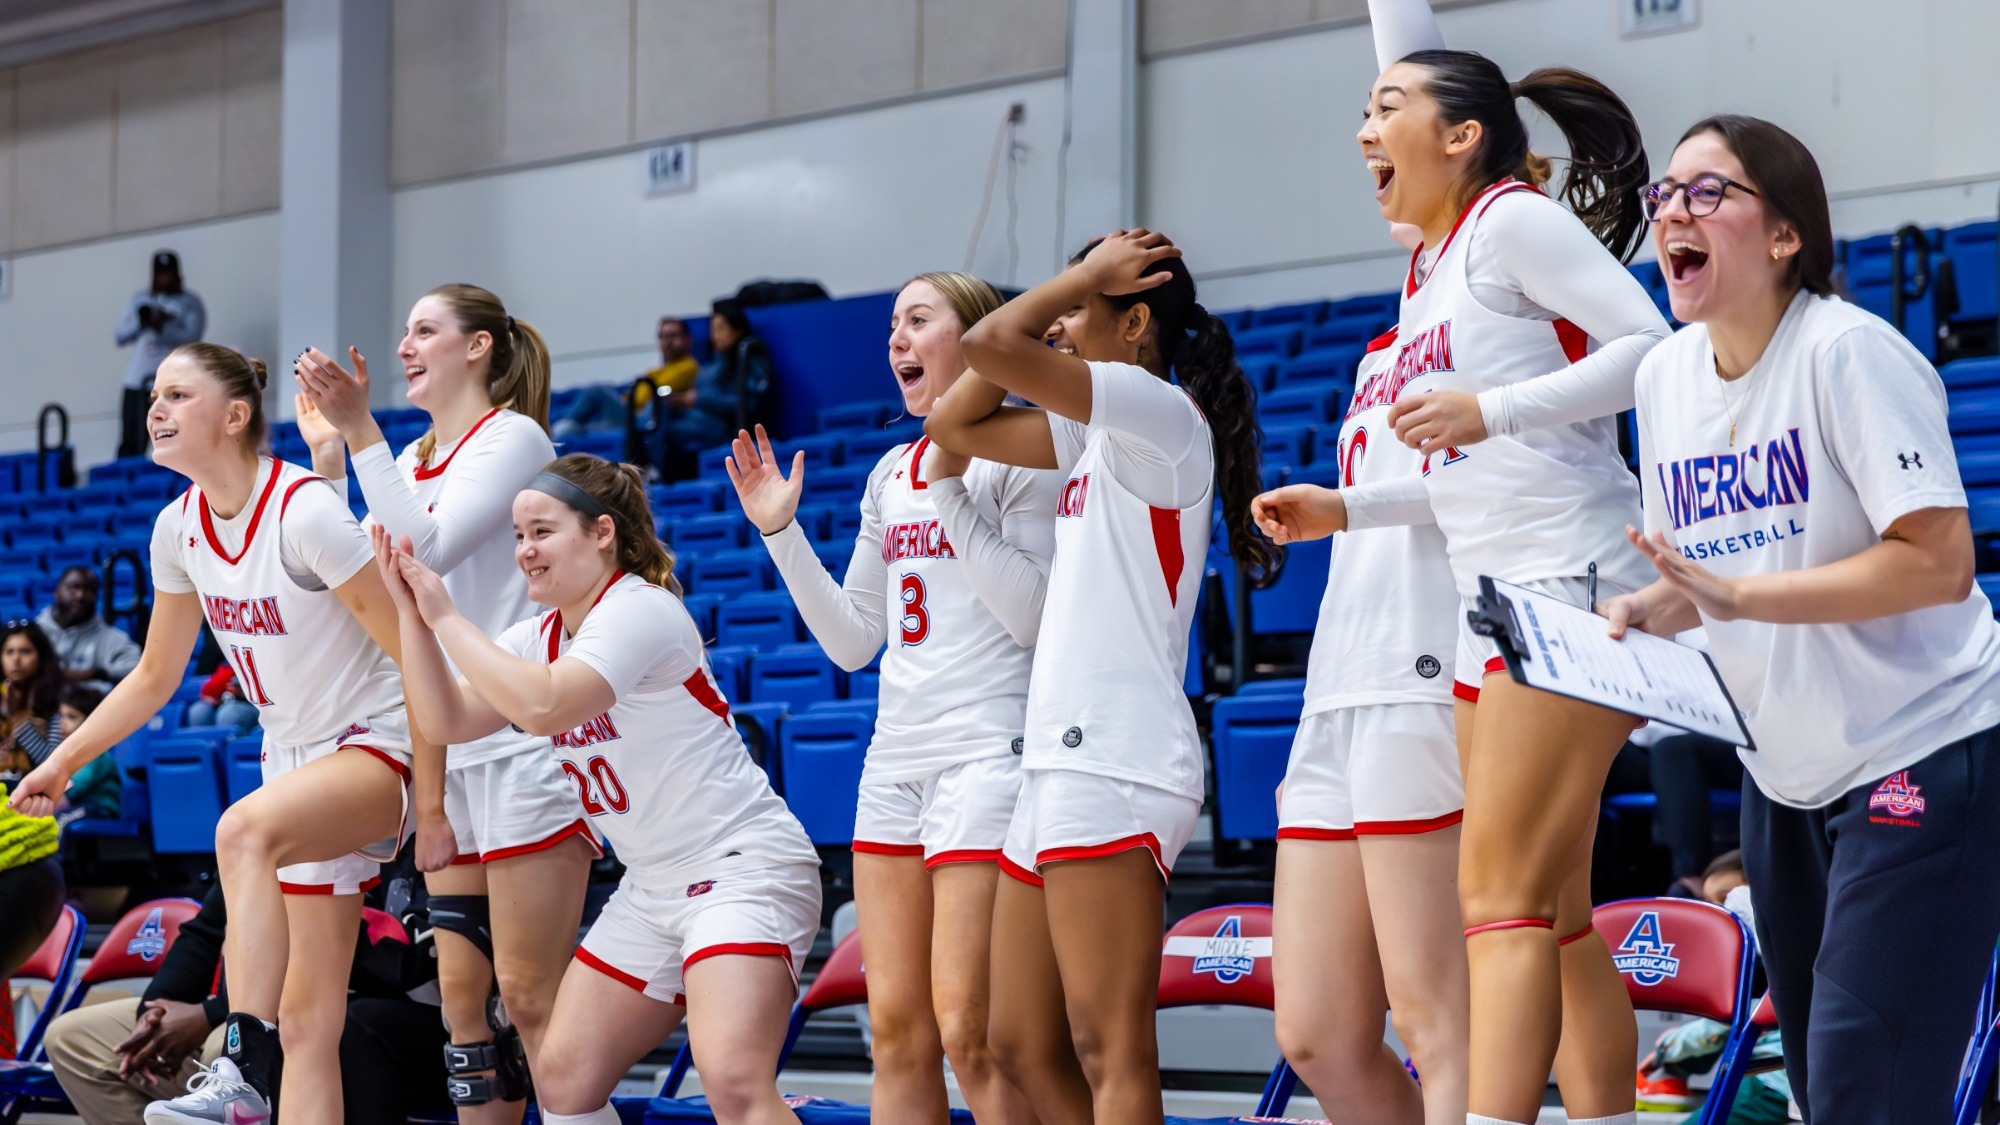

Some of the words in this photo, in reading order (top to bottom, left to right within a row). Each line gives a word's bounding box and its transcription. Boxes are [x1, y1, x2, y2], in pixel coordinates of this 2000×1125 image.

[881, 518, 958, 567] MERICA
[1676, 518, 1804, 561] ASKETBLL
[203, 592, 288, 636] MERICAN
[900, 572, 931, 648] 3
[231, 644, 275, 707] 11
[560, 755, 629, 817] 20
[1872, 795, 1921, 808] AMERICAN
